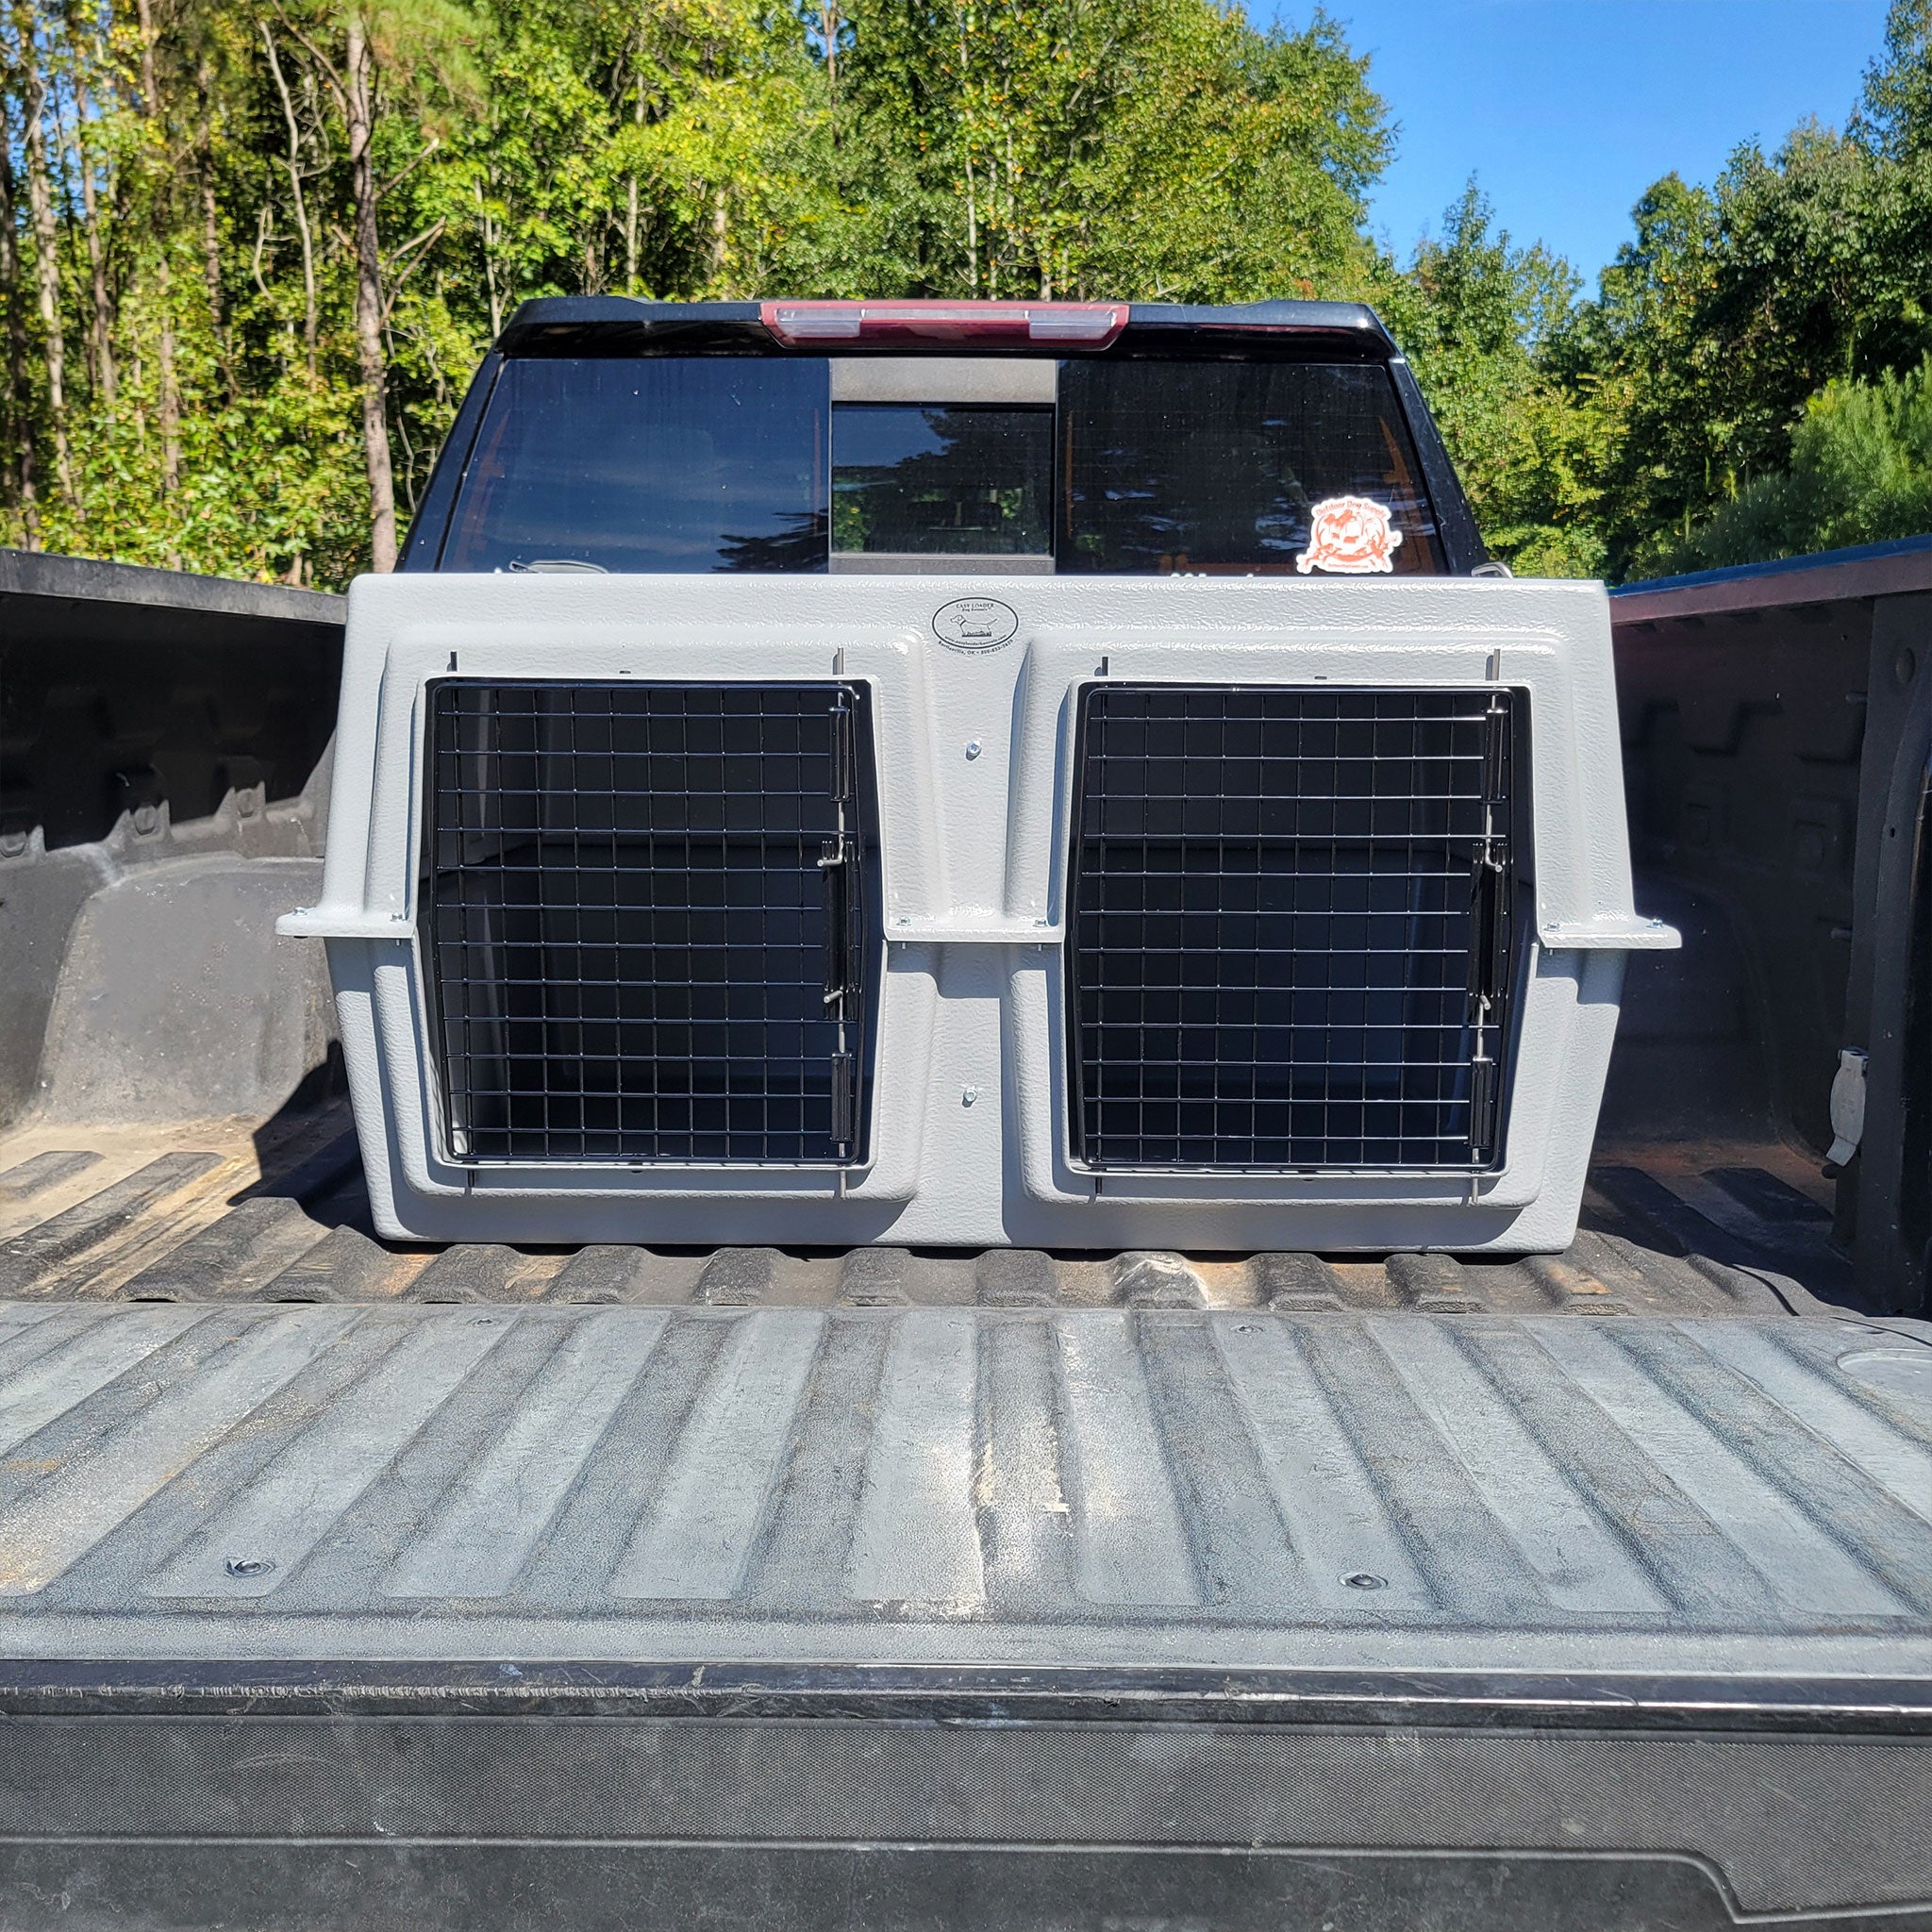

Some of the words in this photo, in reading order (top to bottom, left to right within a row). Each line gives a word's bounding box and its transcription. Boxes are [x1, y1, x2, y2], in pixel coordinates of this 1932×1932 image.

[1316, 502, 1345, 516] Outdoor
[1347, 500, 1361, 509] Dog
[1364, 503, 1387, 519] Supply
